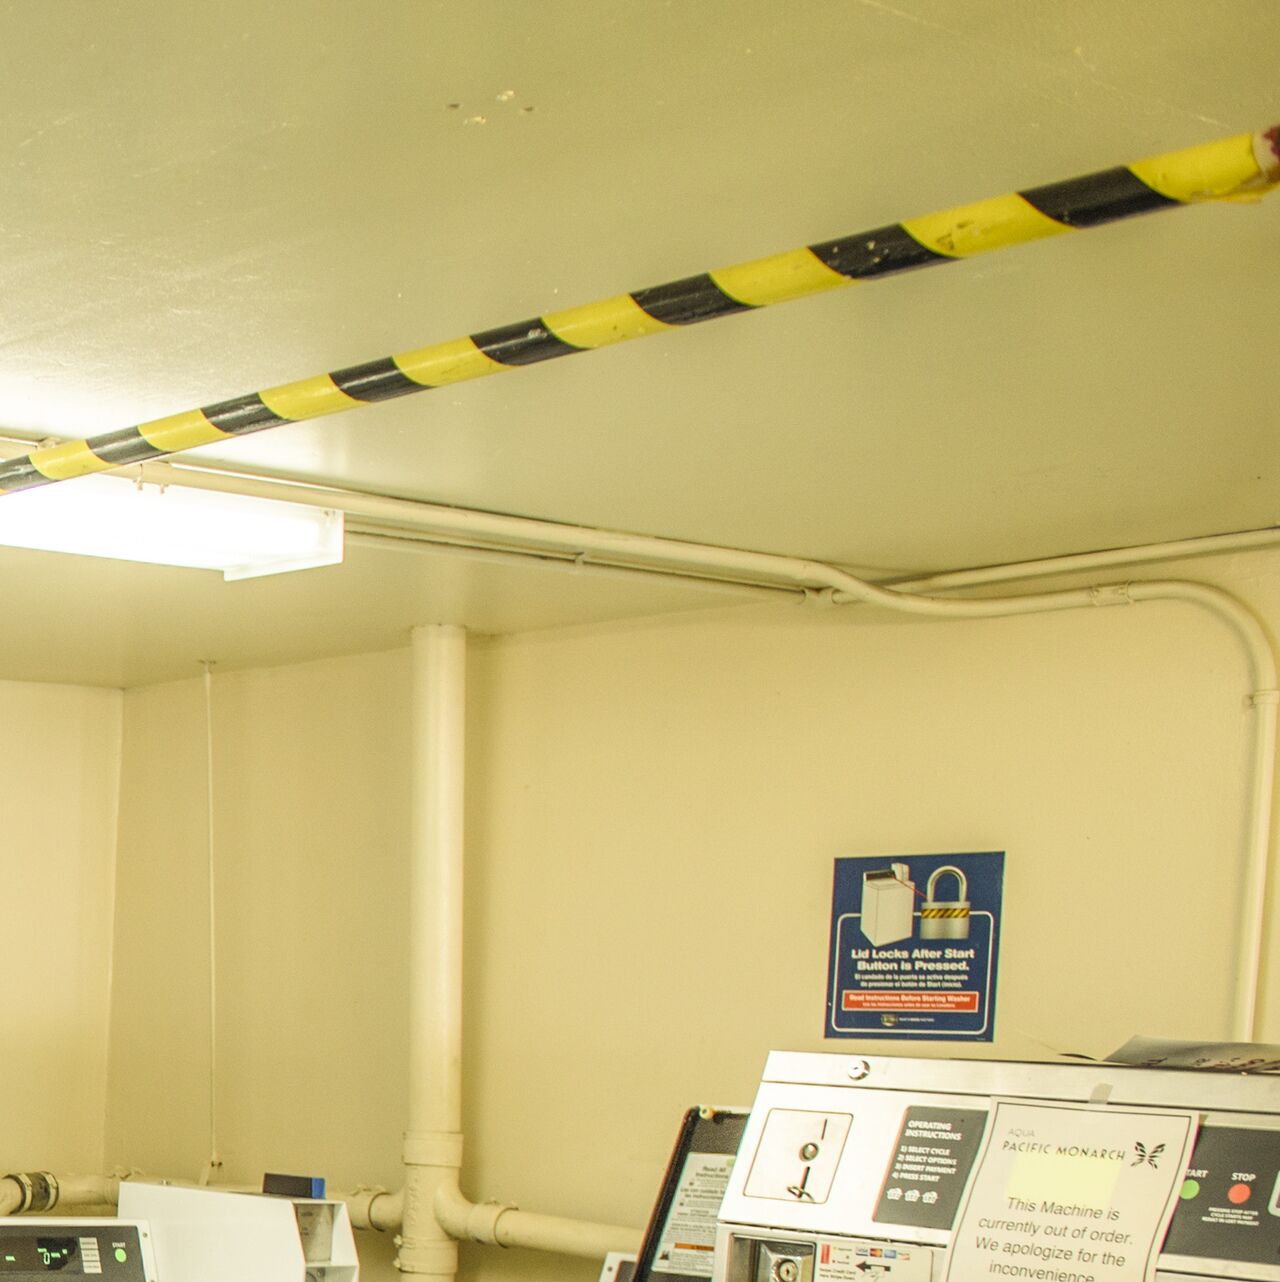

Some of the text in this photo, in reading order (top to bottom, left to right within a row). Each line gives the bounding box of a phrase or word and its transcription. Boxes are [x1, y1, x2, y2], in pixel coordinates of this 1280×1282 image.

[851, 948, 975, 959] Lid Locks After Start
[857, 961, 898, 971] Button
[915, 961, 970, 971] Pressed.
[908, 1120, 952, 1131] OPERATING
[905, 1129, 962, 1141] INSTRUCTIONS
[1008, 1128, 1035, 1137] AQUA
[908, 1146, 930, 1154] SELECT
[930, 1148, 950, 1156] CYCLE
[1002, 1140, 1126, 1161] PACIFIC MONARCH
[905, 1155, 927, 1163] SELECT
[919, 1174, 940, 1182] START
[1186, 1169, 1209, 1178] TART
[1231, 1172, 1256, 1182] STOP
[1008, 1197, 1120, 1221] This Machine is
[978, 1217, 1134, 1245] currently out of order.
[975, 1236, 1126, 1267] We apologize for the
